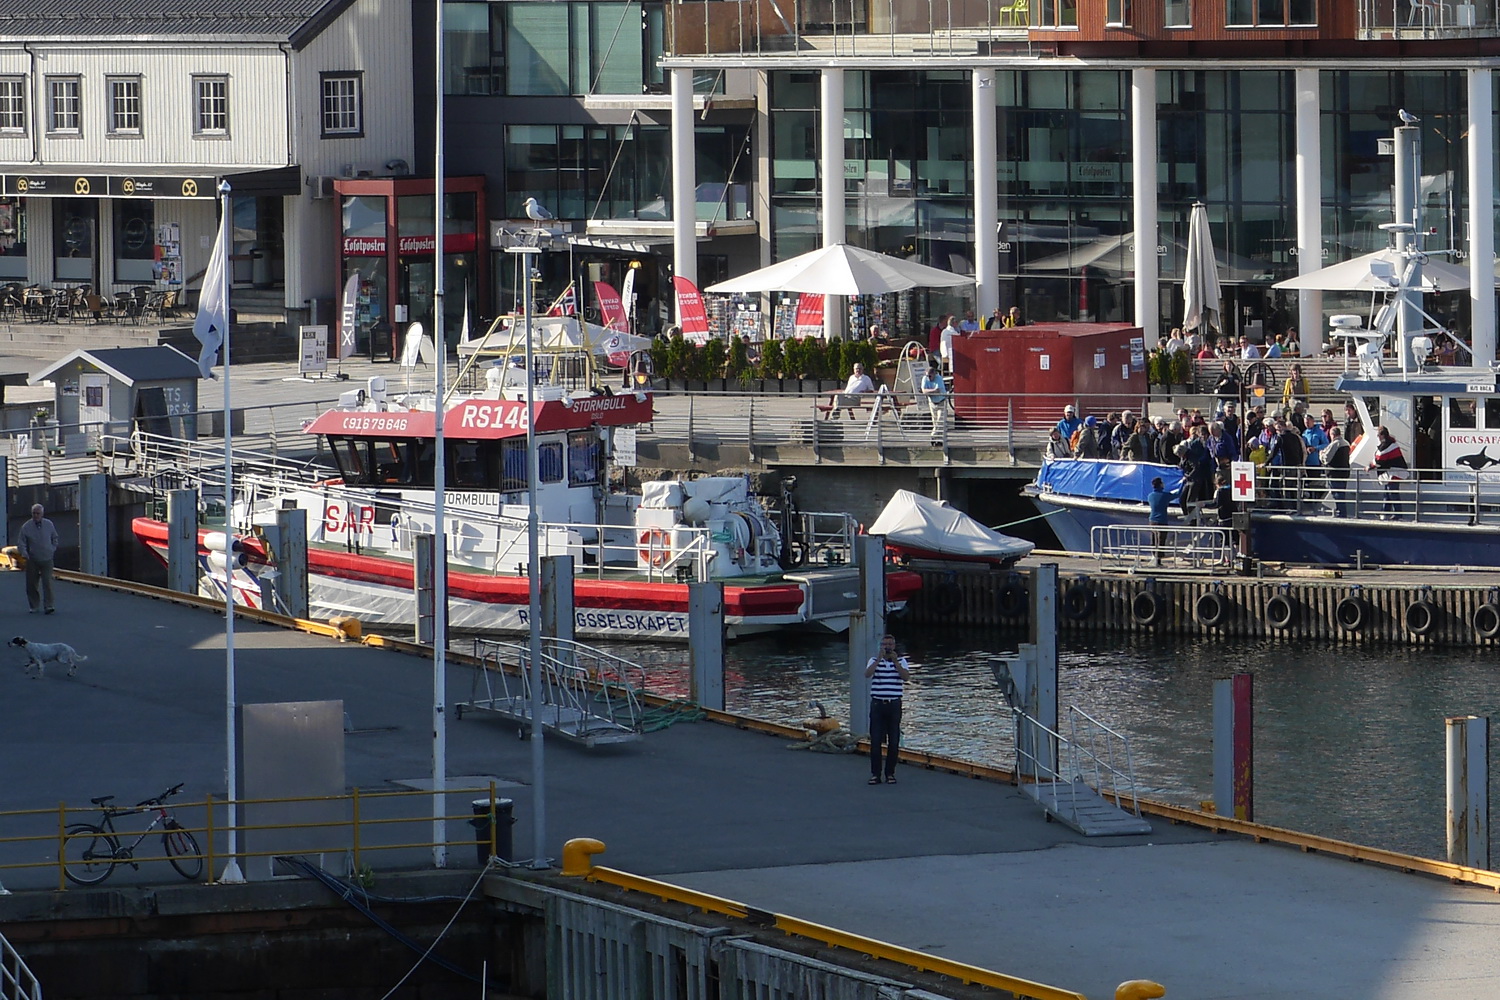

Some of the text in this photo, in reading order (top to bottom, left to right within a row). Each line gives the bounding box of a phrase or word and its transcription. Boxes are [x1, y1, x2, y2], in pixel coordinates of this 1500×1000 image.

[344, 238, 386, 254] Lofotposten
[400, 238, 435, 254] Lofotposten
[342, 291, 353, 346] LEX
[572, 397, 626, 413] STORMBULL
[443, 493, 498, 506] TORMBULL
[325, 505, 375, 534] SAR
